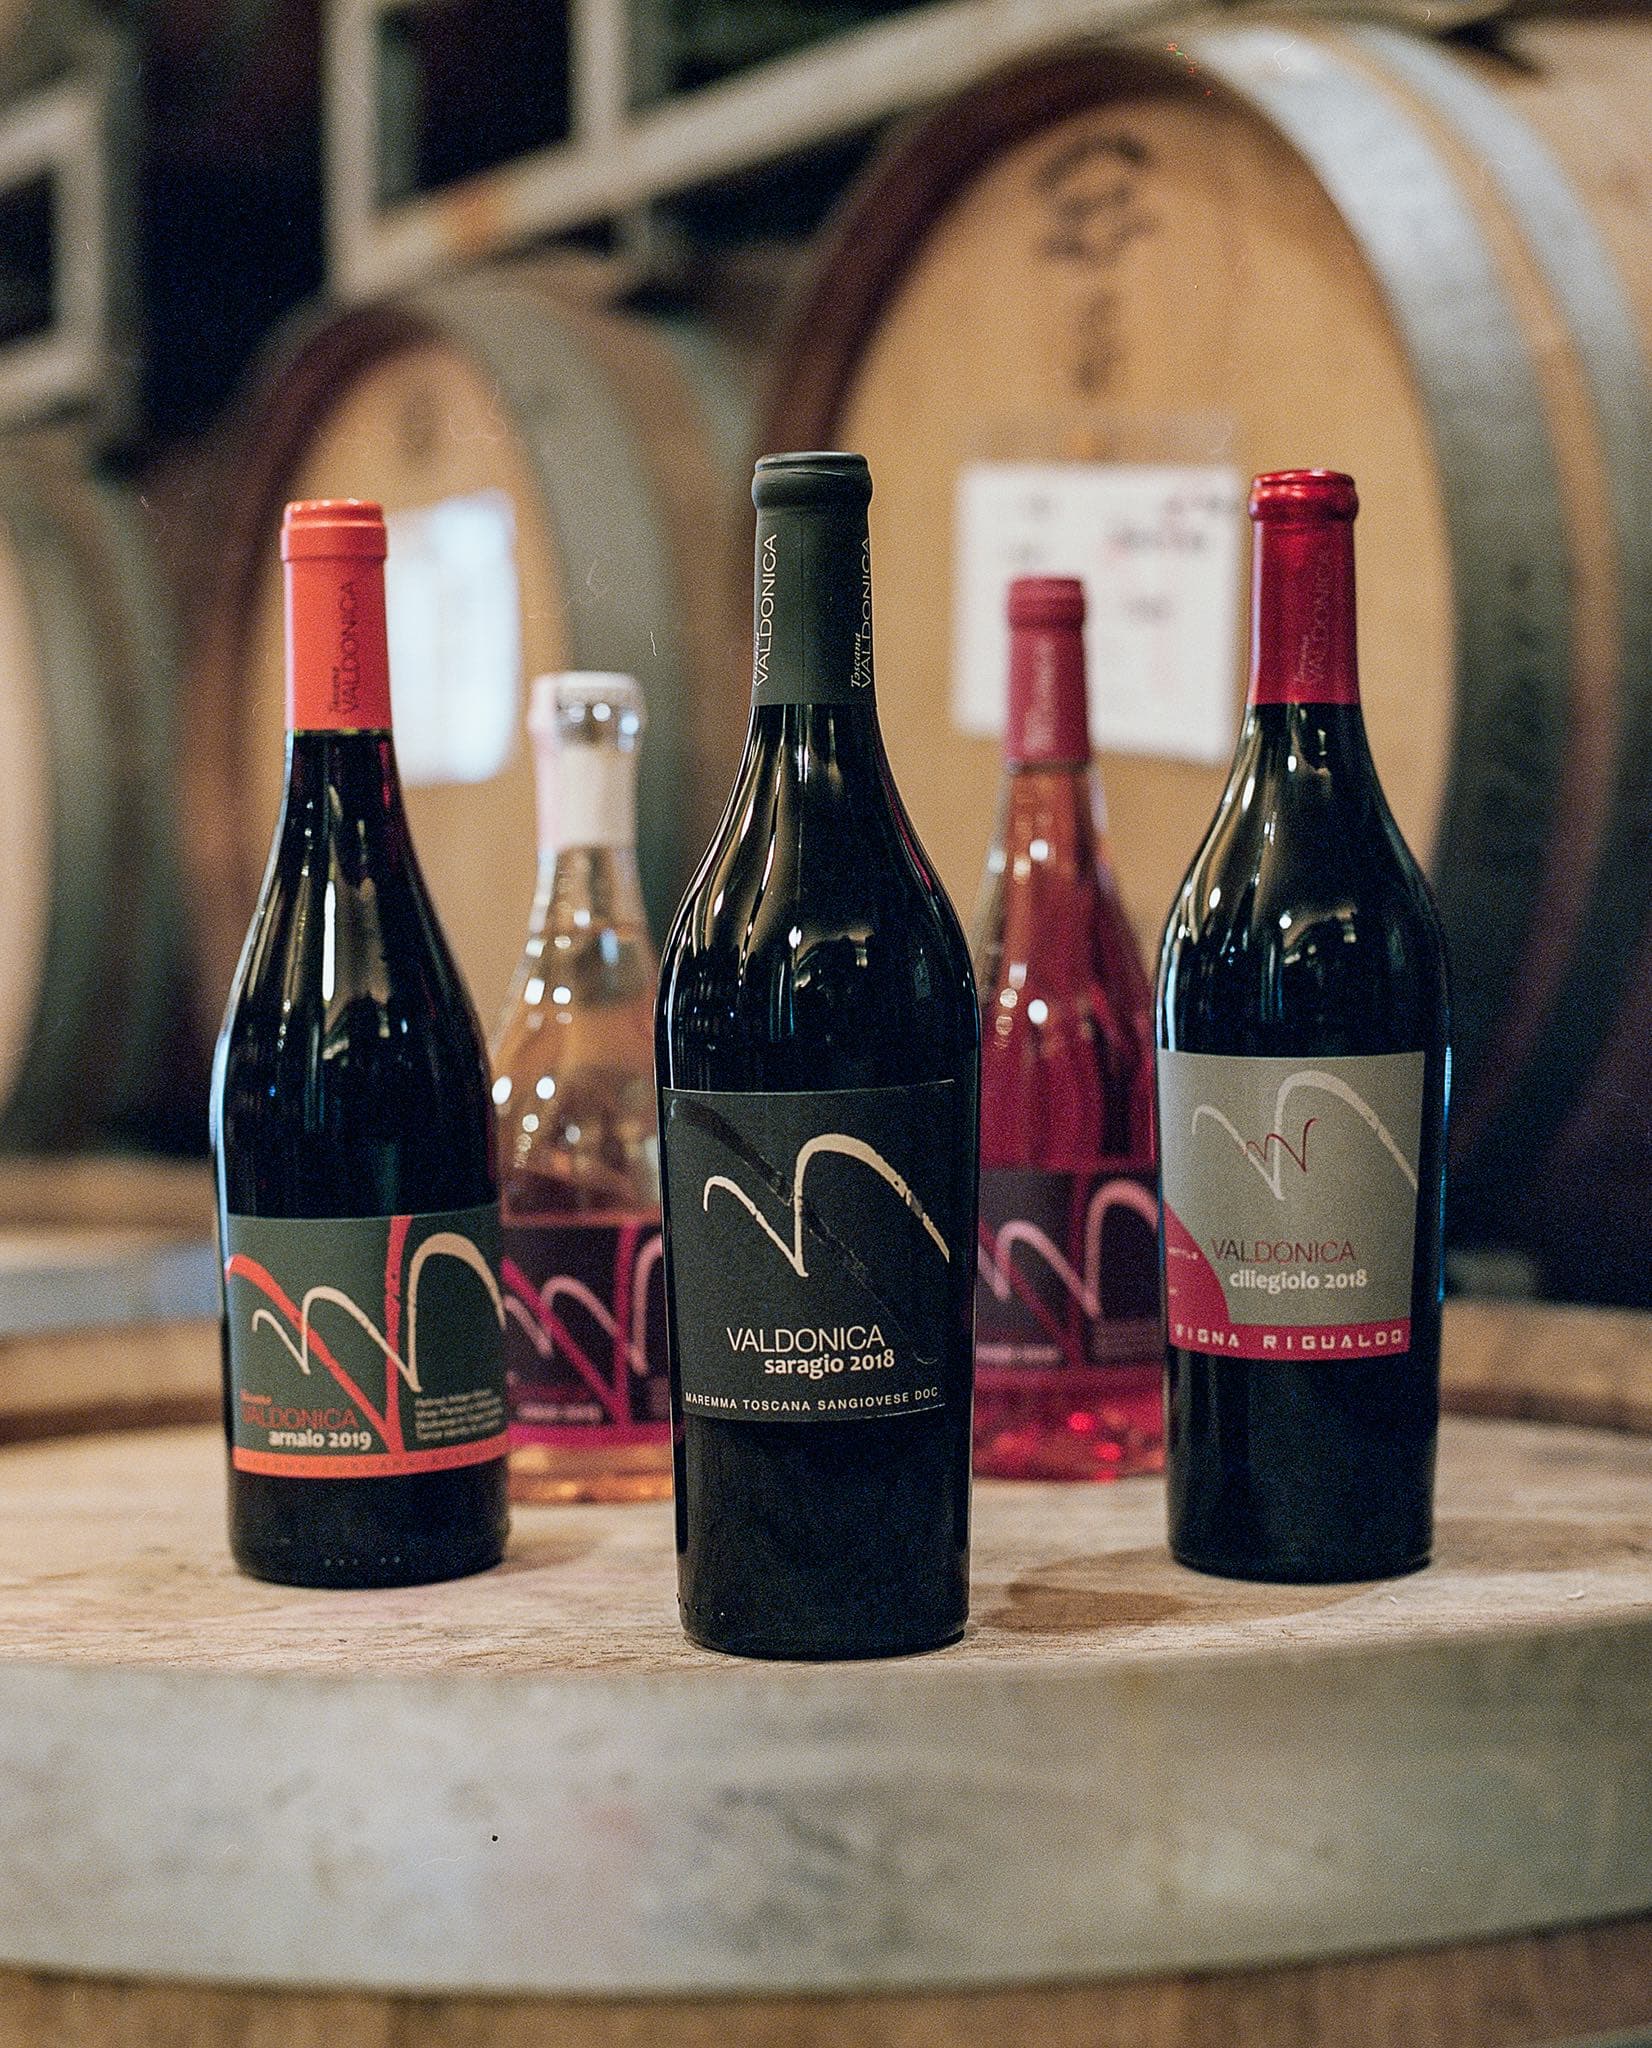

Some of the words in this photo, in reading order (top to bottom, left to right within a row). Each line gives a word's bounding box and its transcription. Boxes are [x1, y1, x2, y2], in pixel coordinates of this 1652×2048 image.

[755, 534, 777, 687] VALDONICA
[861, 537, 871, 688] VALDONICA
[339, 581, 360, 714] VALDONICA
[851, 633, 861, 688] Toscana
[1211, 1237, 1356, 1264] VALDONICA
[1229, 1269, 1319, 1295] ciliegiolo
[1324, 1268, 1367, 1289] 2018
[726, 1324, 886, 1353] VALDONICA
[1263, 1329, 1401, 1351] RIGUALDO
[764, 1353, 844, 1380] saragio
[850, 1349, 895, 1371] 2018
[685, 1391, 738, 1410] MAREMMA
[743, 1399, 811, 1412] TOSCANA
[817, 1391, 909, 1412] SANGIOVESE
[914, 1386, 939, 1400] DOC
[328, 1431, 372, 1452] 2019
